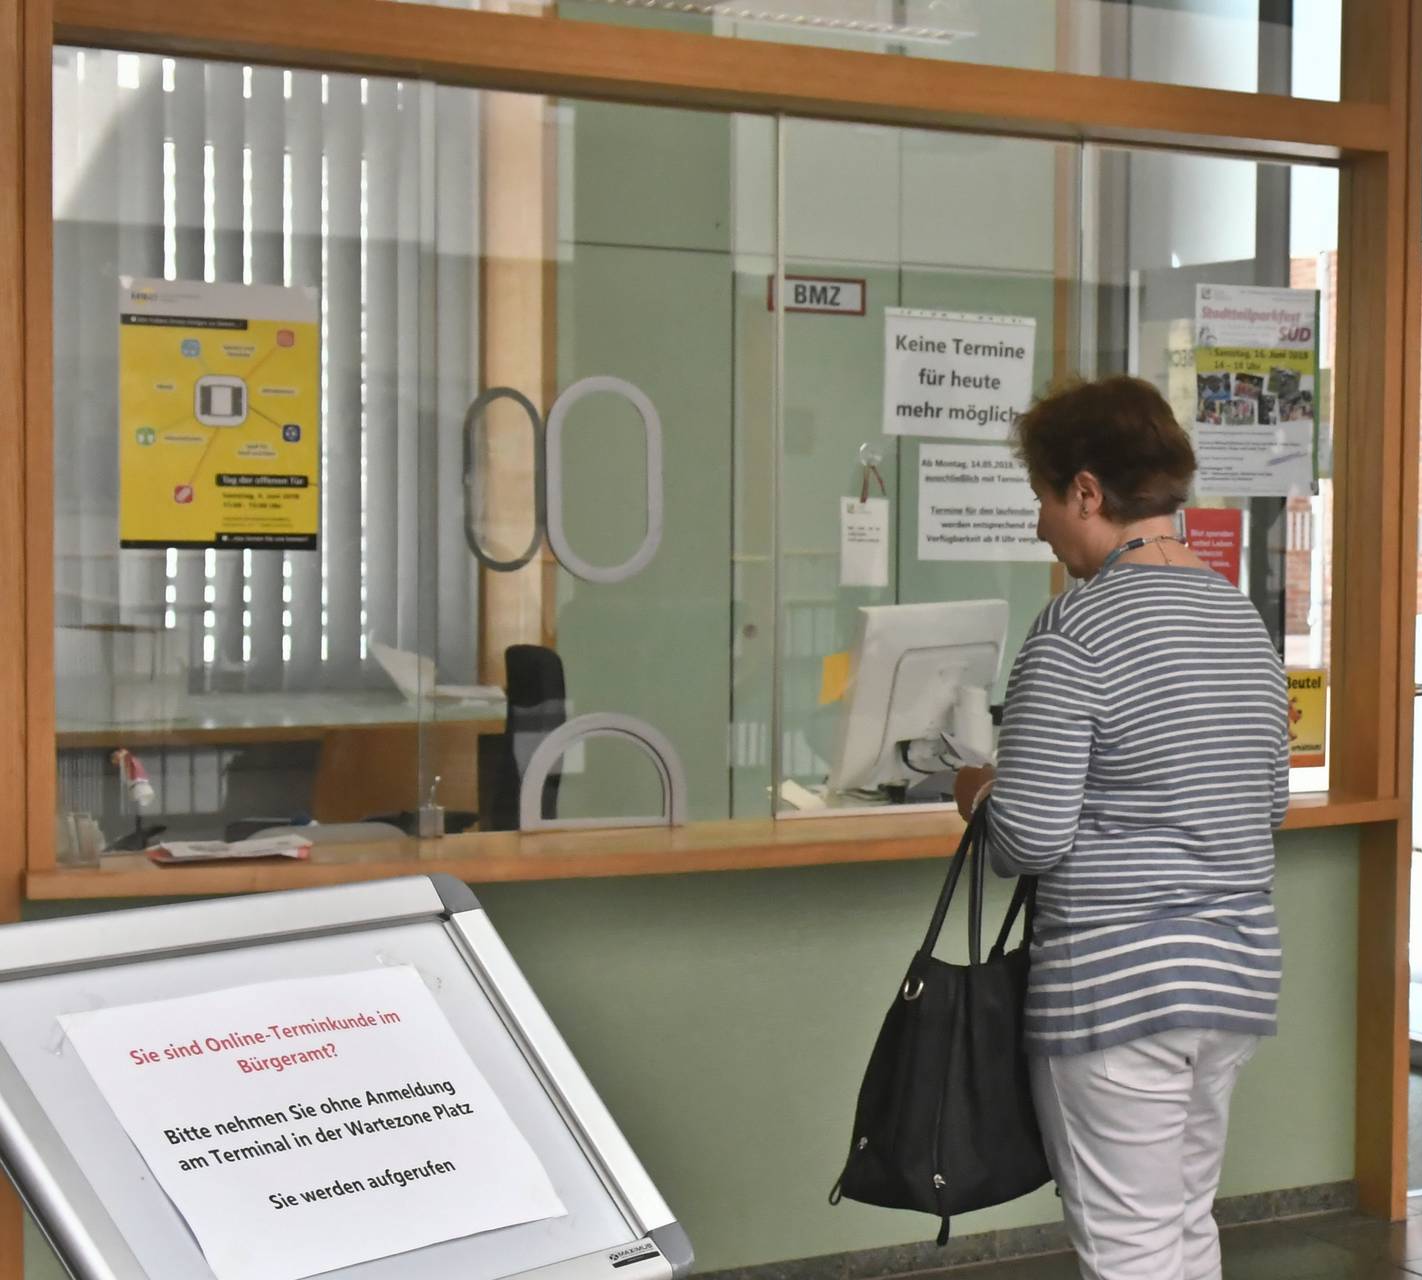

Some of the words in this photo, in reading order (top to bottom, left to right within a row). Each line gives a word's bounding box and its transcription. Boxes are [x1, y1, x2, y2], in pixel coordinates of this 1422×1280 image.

[793, 284, 841, 306] BMZ
[895, 335, 947, 354] Keine
[952, 338, 1025, 359] Termine
[918, 368, 945, 386] für
[951, 370, 1001, 390] heute
[895, 401, 944, 419] mehr
[948, 404, 1020, 426] möglich
[130, 1050, 160, 1066] Sie
[164, 1040, 203, 1060] sind
[205, 1012, 378, 1052] Online-Terminkunde
[376, 1010, 401, 1025] im
[237, 1043, 338, 1074] Bürgeramt?
[163, 1125, 212, 1145] Bitte
[215, 1110, 288, 1136] nehmen
[288, 1103, 317, 1121] Sie
[320, 1095, 362, 1114] ohne
[365, 1079, 456, 1107] Anmeldung
[178, 1154, 209, 1171] am
[208, 1135, 292, 1166] Terminal
[291, 1132, 312, 1149] in
[315, 1125, 343, 1144] der
[344, 1109, 433, 1138] Wartezone
[432, 1101, 475, 1120] Platz
[268, 1193, 299, 1210] Sie
[300, 1177, 366, 1203] werden
[367, 1158, 457, 1188] aufgerufen
